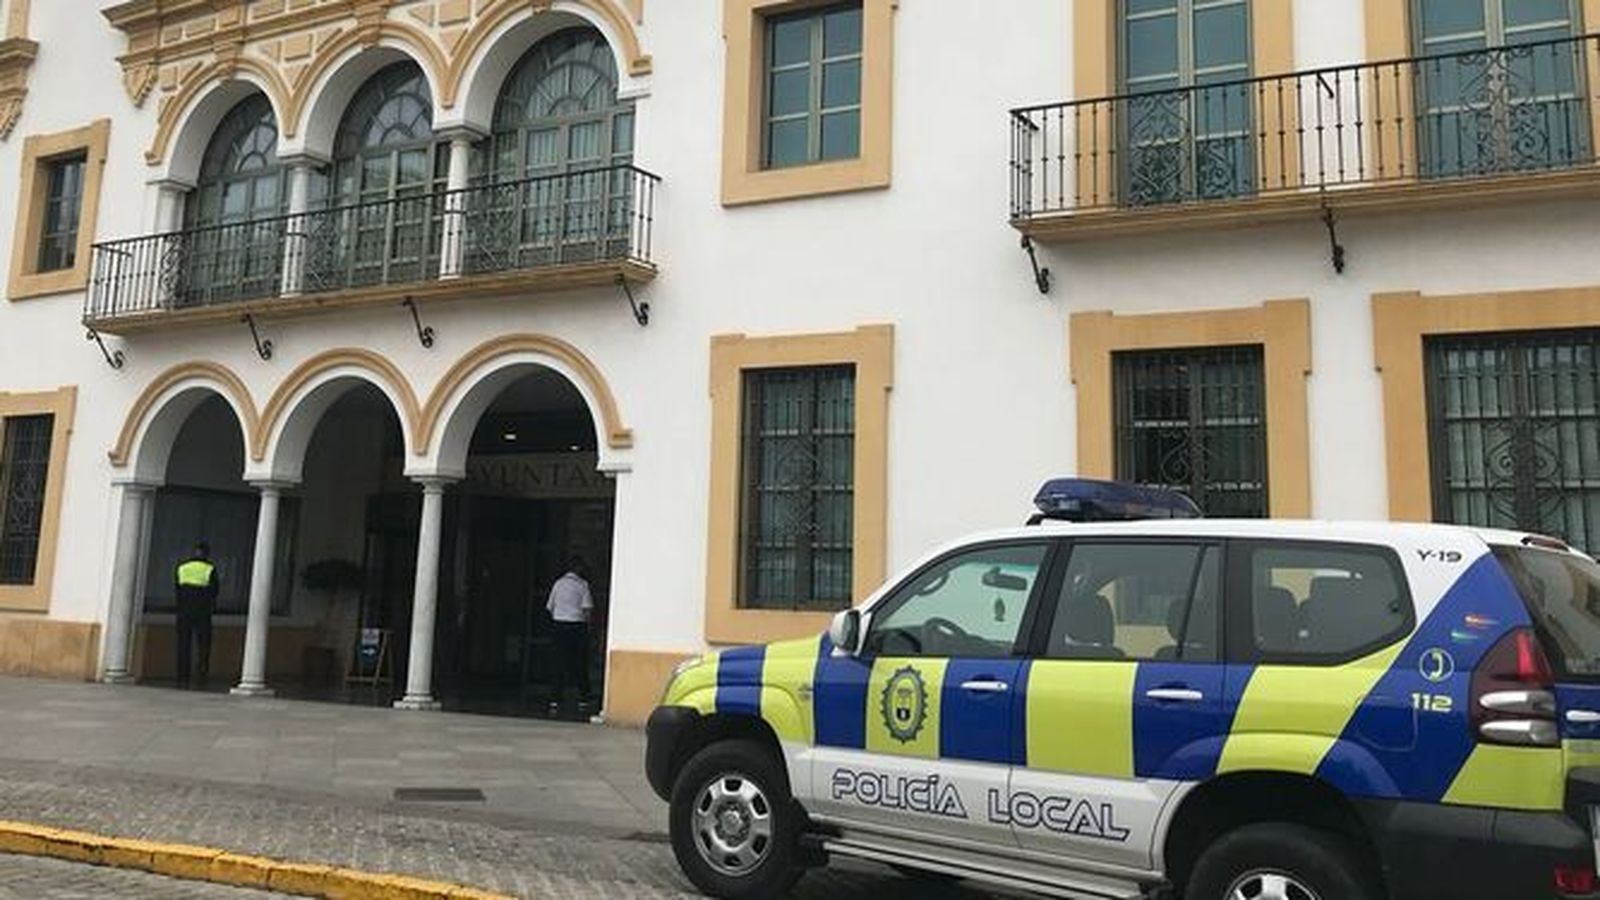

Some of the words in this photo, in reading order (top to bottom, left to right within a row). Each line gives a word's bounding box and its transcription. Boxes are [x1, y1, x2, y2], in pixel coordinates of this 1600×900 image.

[1417, 550, 1462, 563] Y-19
[1411, 693, 1453, 712] 112
[832, 768, 967, 818] POLICÍA
[988, 788, 1130, 842] LOCAL
